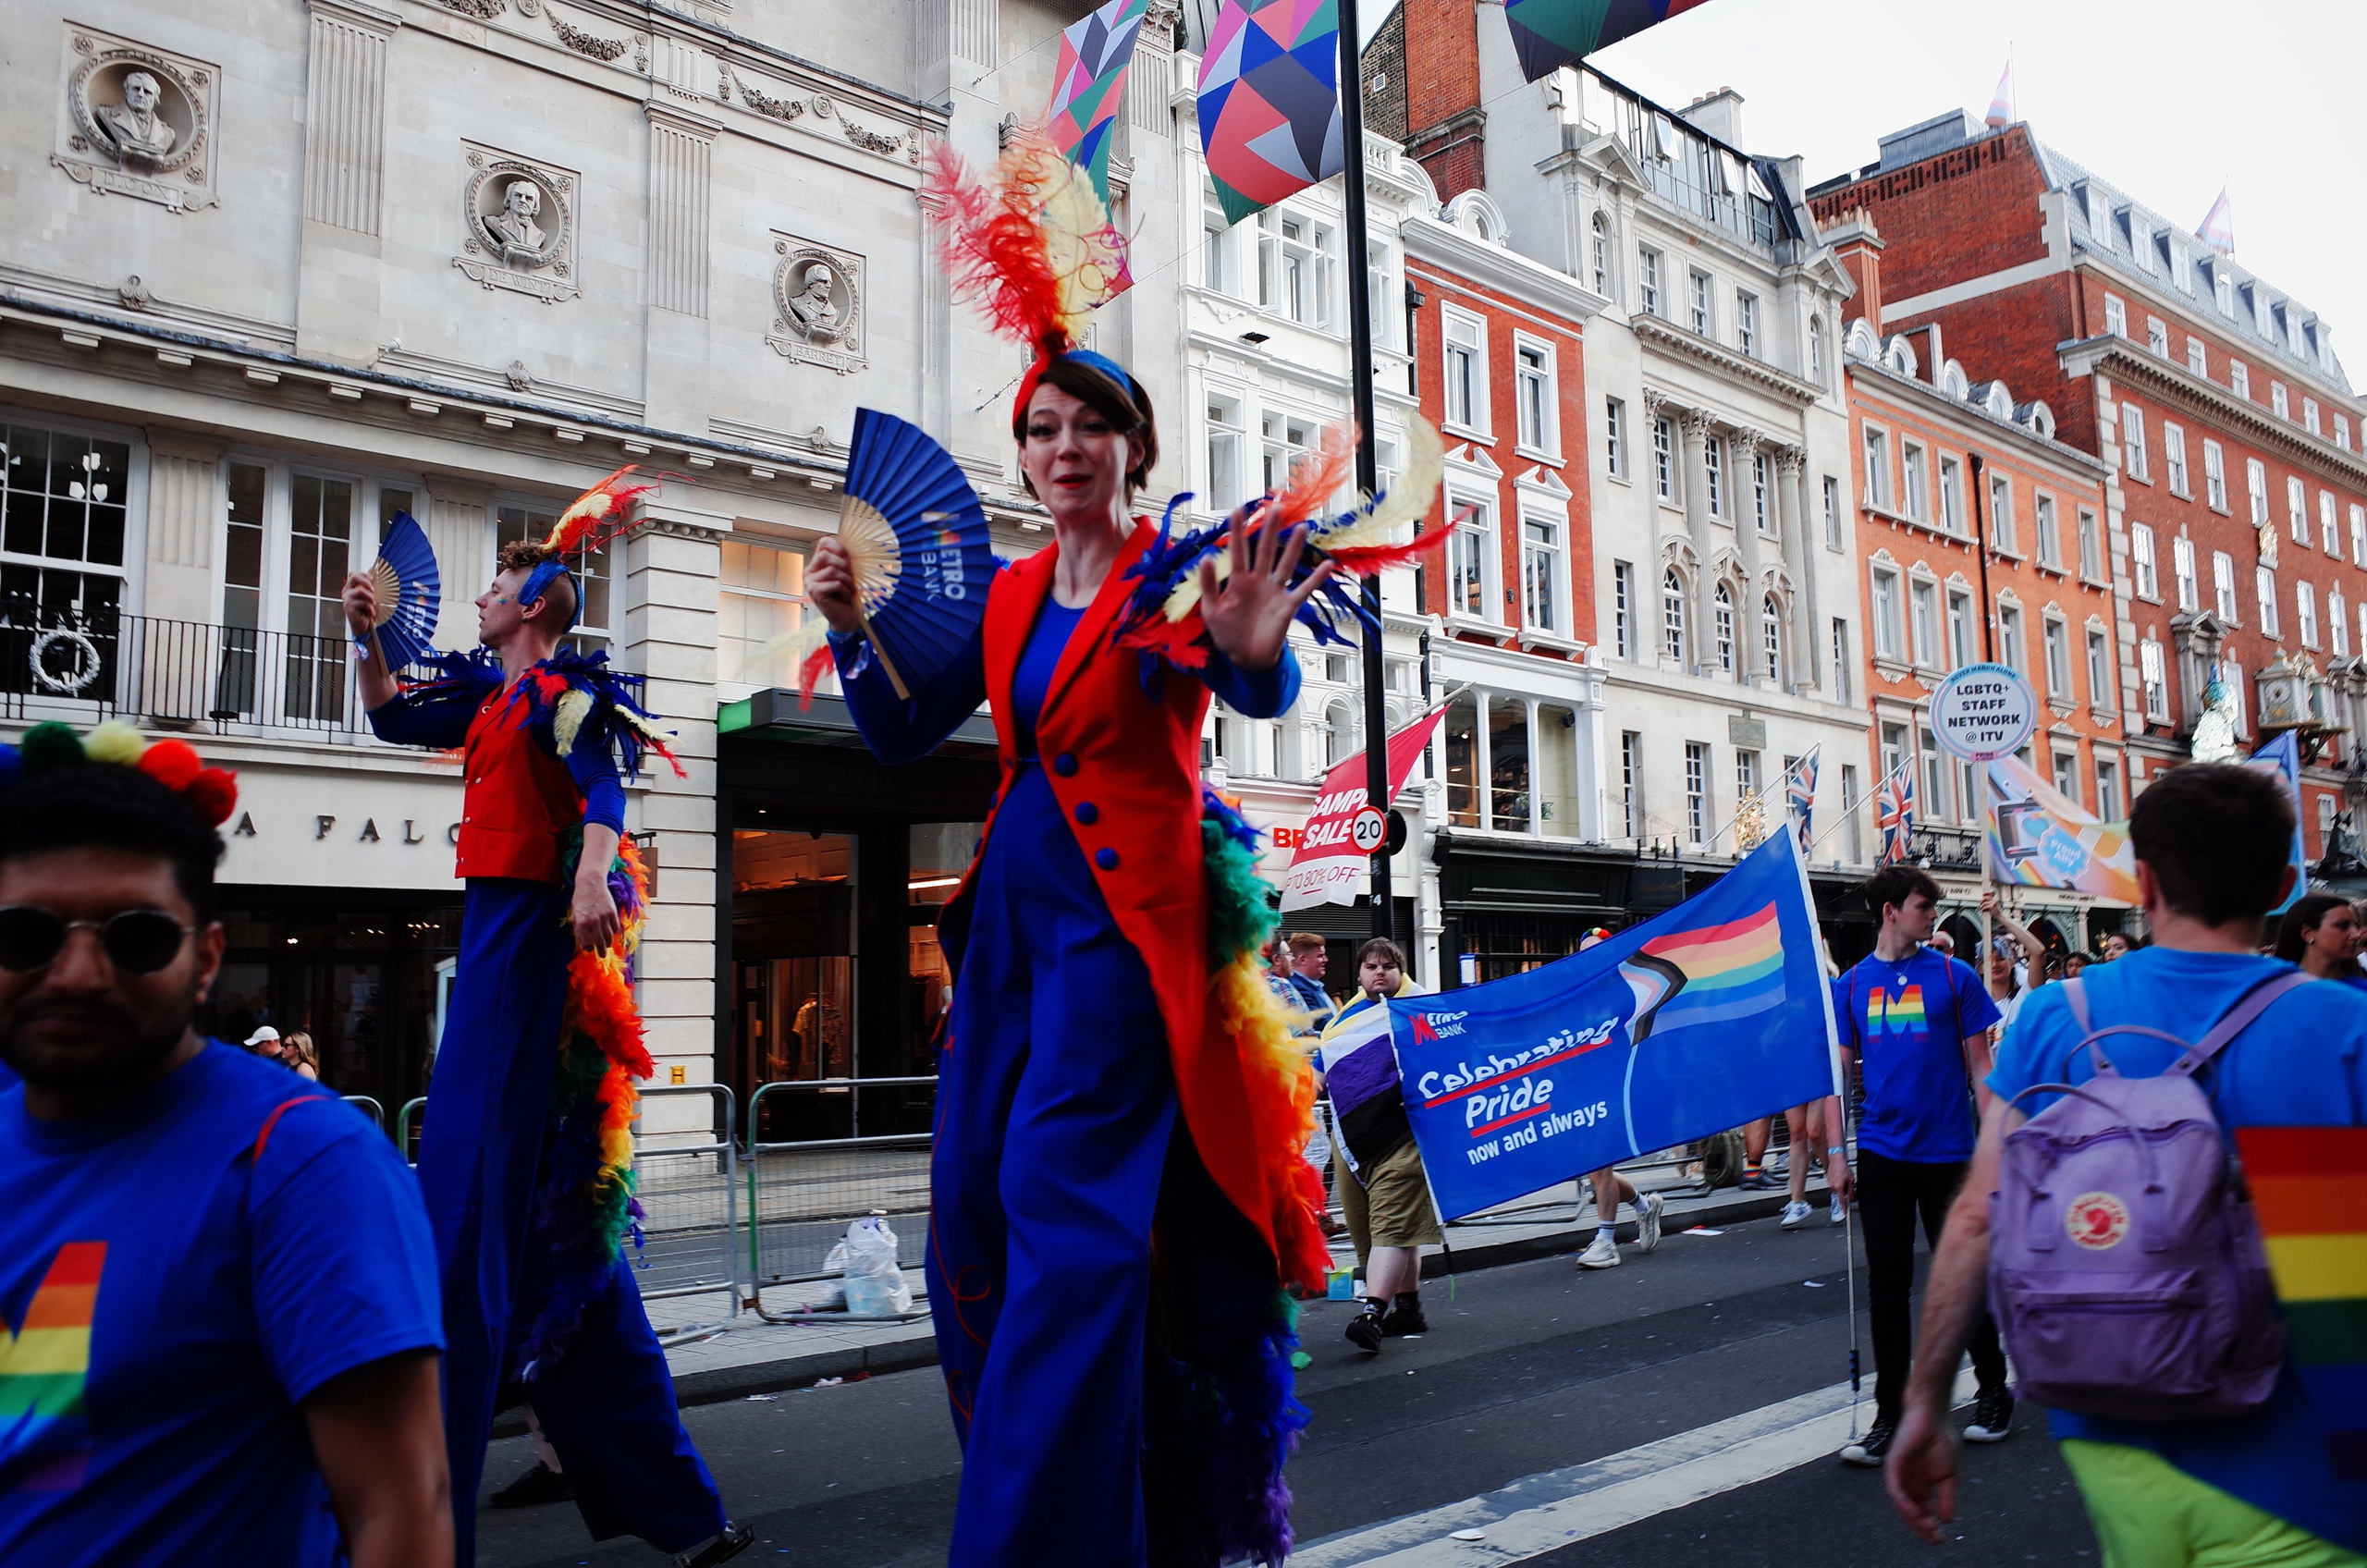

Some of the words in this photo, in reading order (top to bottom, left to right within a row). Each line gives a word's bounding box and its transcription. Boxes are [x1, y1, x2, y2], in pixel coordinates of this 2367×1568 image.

[921, 551, 942, 601] BANK
[1956, 683, 2011, 696] LGBTQ+
[1961, 698, 2006, 711] STAFF
[1947, 713, 2021, 729] NETWORK
[1965, 731, 1978, 744] @
[1980, 730, 2005, 742] ITV
[1310, 785, 1394, 818] SAMPL
[1303, 818, 1354, 850] SALE
[1356, 819, 1381, 840] 20
[1328, 865, 1361, 884] OFF
[1408, 1011, 1468, 1046] METRO
[1436, 1022, 1466, 1039] BANK
[1417, 1016, 1620, 1099] Celebrating
[1466, 1076, 1554, 1130] Pride
[1466, 1139, 1500, 1166] now
[1503, 1121, 1539, 1153] and
[1540, 1100, 1609, 1141] always
